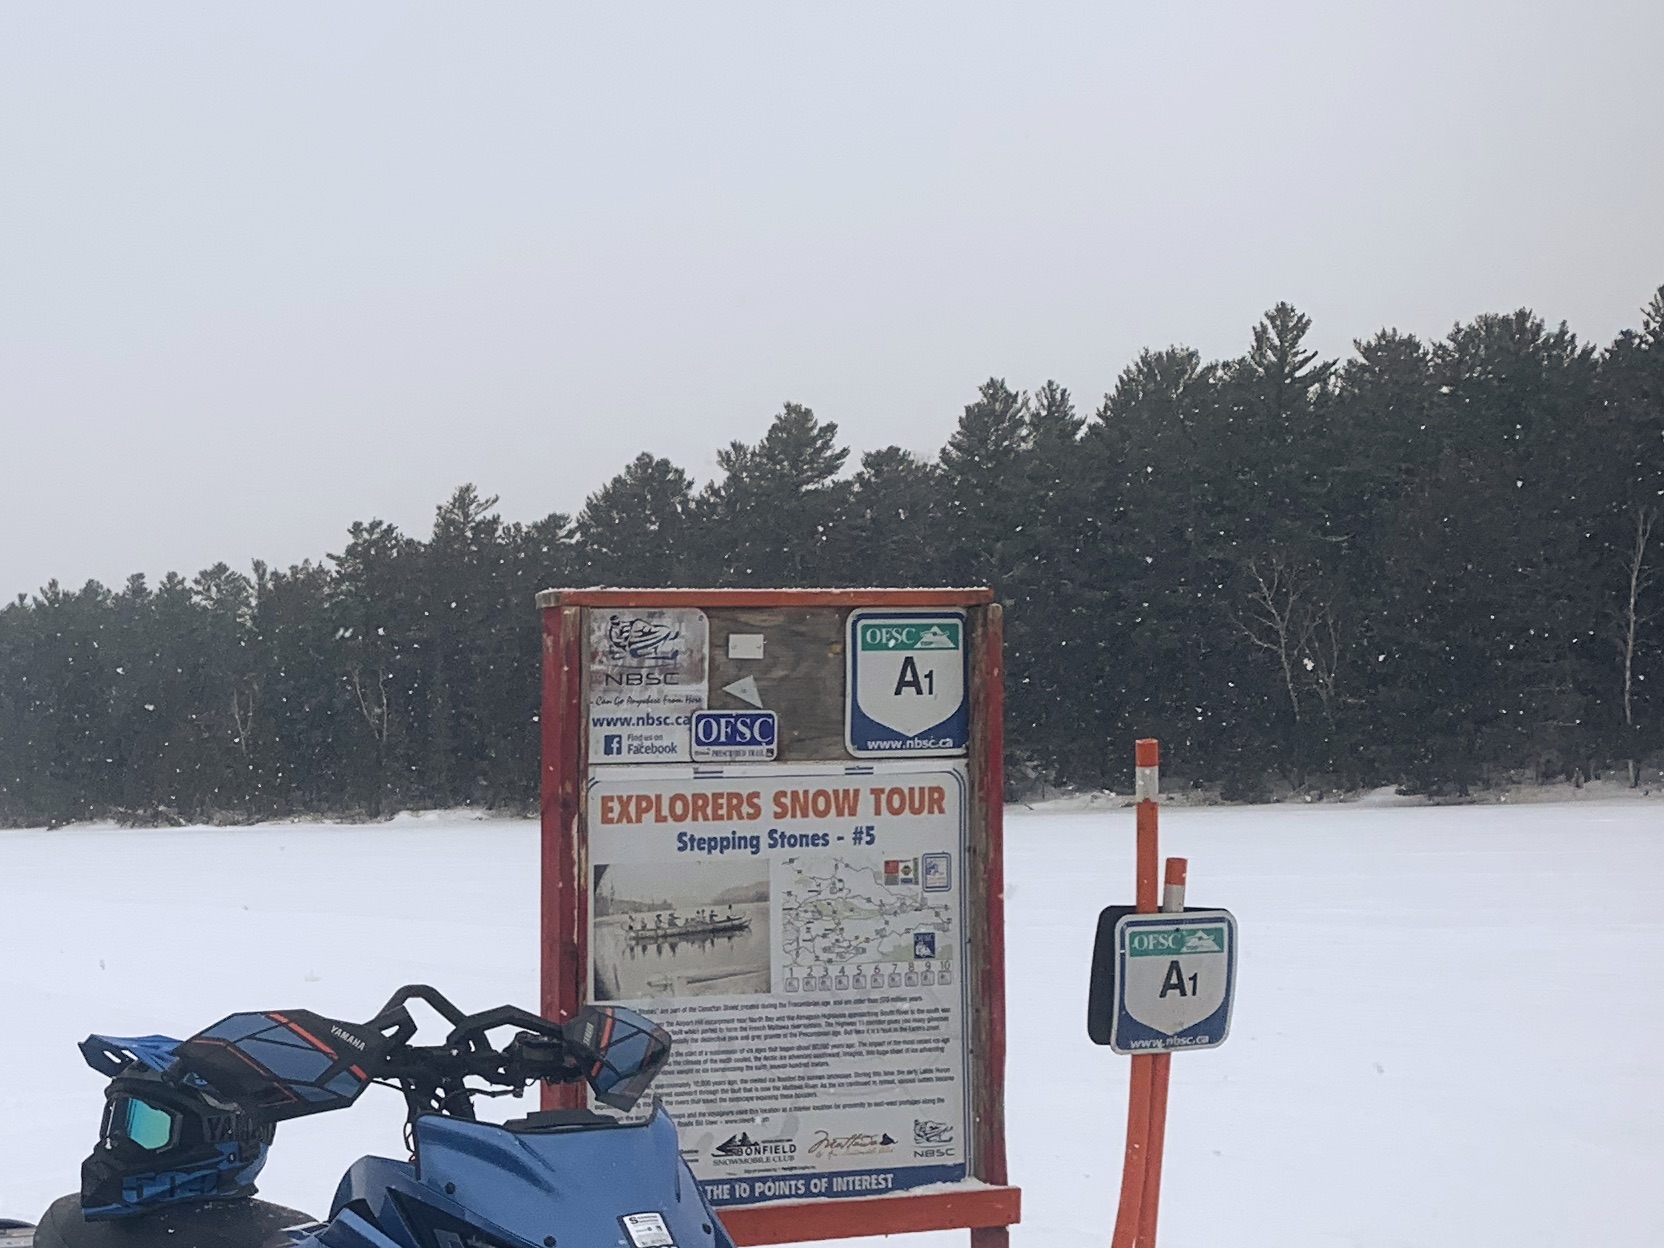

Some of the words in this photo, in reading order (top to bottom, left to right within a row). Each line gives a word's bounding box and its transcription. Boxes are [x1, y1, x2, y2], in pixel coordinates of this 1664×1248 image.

[866, 628, 916, 644] OFSC
[605, 672, 680, 686] NBSC
[894, 656, 934, 696] A1
[592, 712, 690, 728] www.nbsc.ca
[698, 718, 773, 743] OFSC
[627, 742, 677, 756] Facebook
[866, 738, 953, 750] www.nbsc.ca
[601, 791, 762, 825] EXPLORERS
[773, 788, 860, 820] SNOW
[870, 786, 946, 816] TOUR
[677, 830, 760, 855] Stepping
[767, 828, 830, 849] Stones
[852, 826, 876, 846] #5
[1134, 934, 1182, 950] OFSC
[1159, 960, 1198, 998] A1
[330, 1024, 366, 1050] YAMAHA
[737, 1144, 796, 1156] BONFIELD
[913, 1148, 955, 1158] NBSC
[712, 1156, 772, 1167] SNOWMOBILE
[772, 1154, 795, 1163] CLUB
[706, 1184, 731, 1200] THE
[735, 1184, 750, 1198] 10
[754, 1180, 806, 1198] POINTS
[810, 1178, 828, 1193] OF
[833, 1174, 894, 1192] INTEREST
